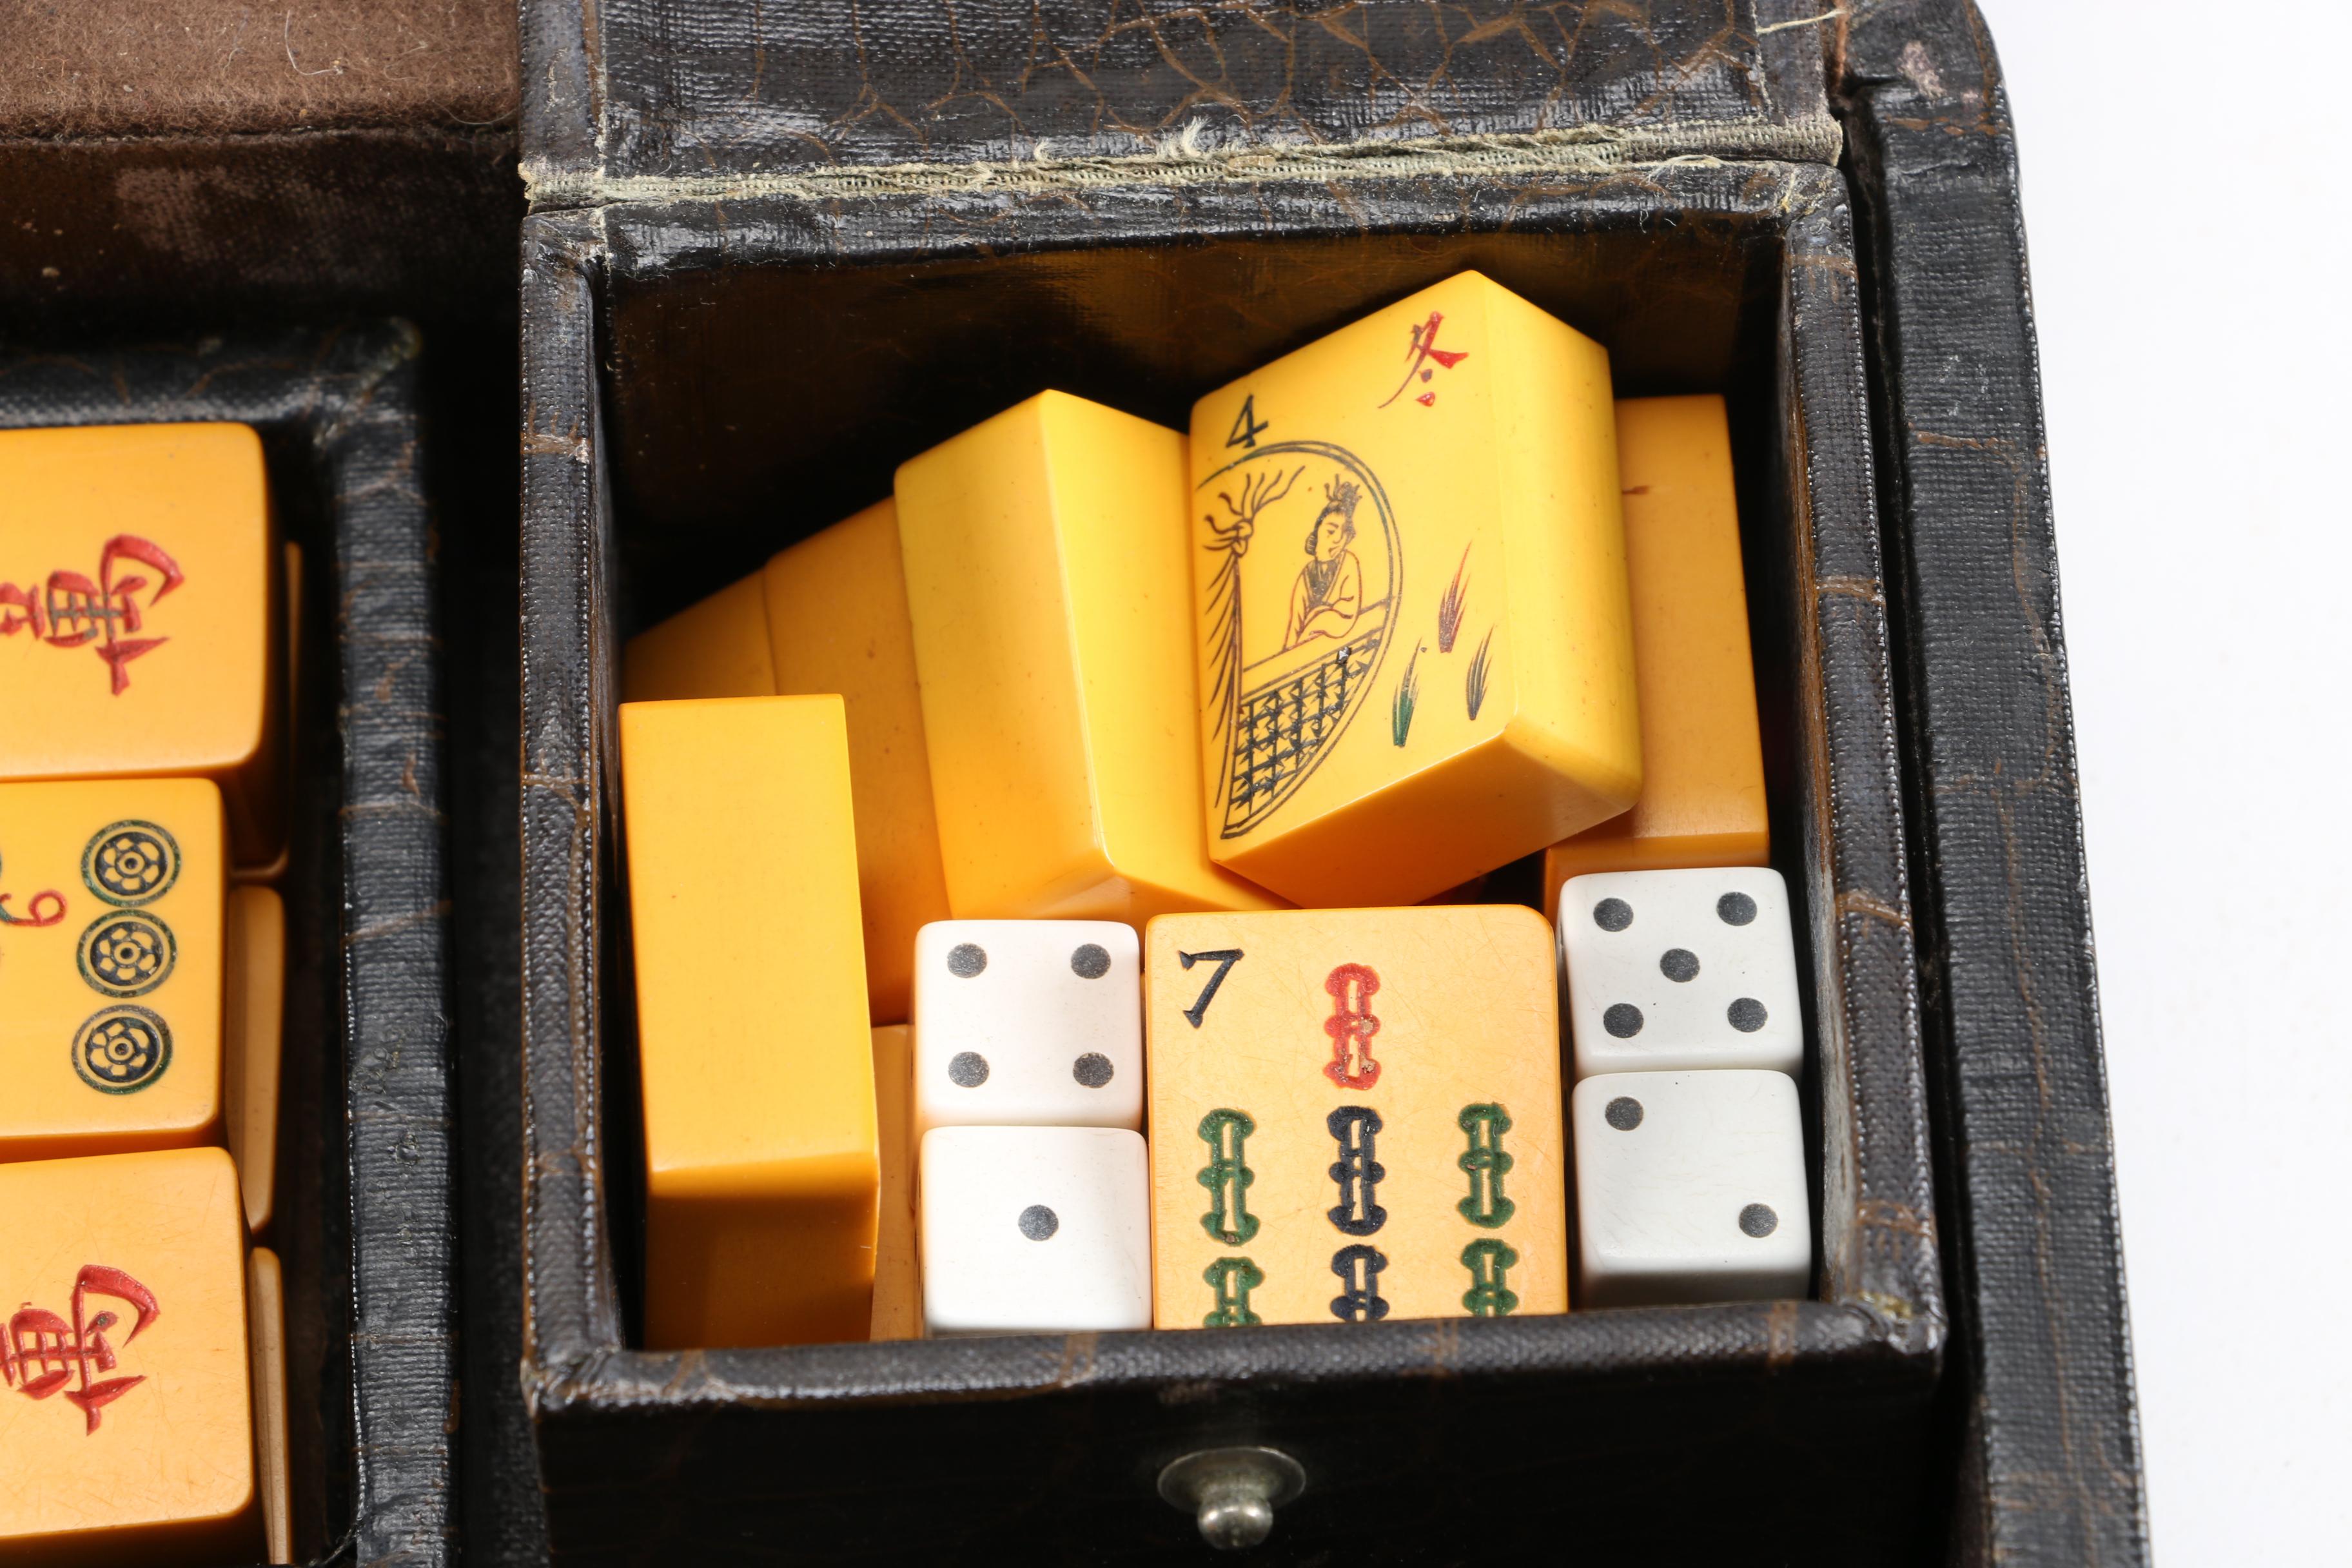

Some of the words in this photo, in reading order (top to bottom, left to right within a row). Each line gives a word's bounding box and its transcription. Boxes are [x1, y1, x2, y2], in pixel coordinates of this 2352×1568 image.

[1377, 311, 1469, 408] 冬
[1226, 393, 1269, 448] 4
[1177, 948, 1244, 1028] 7
